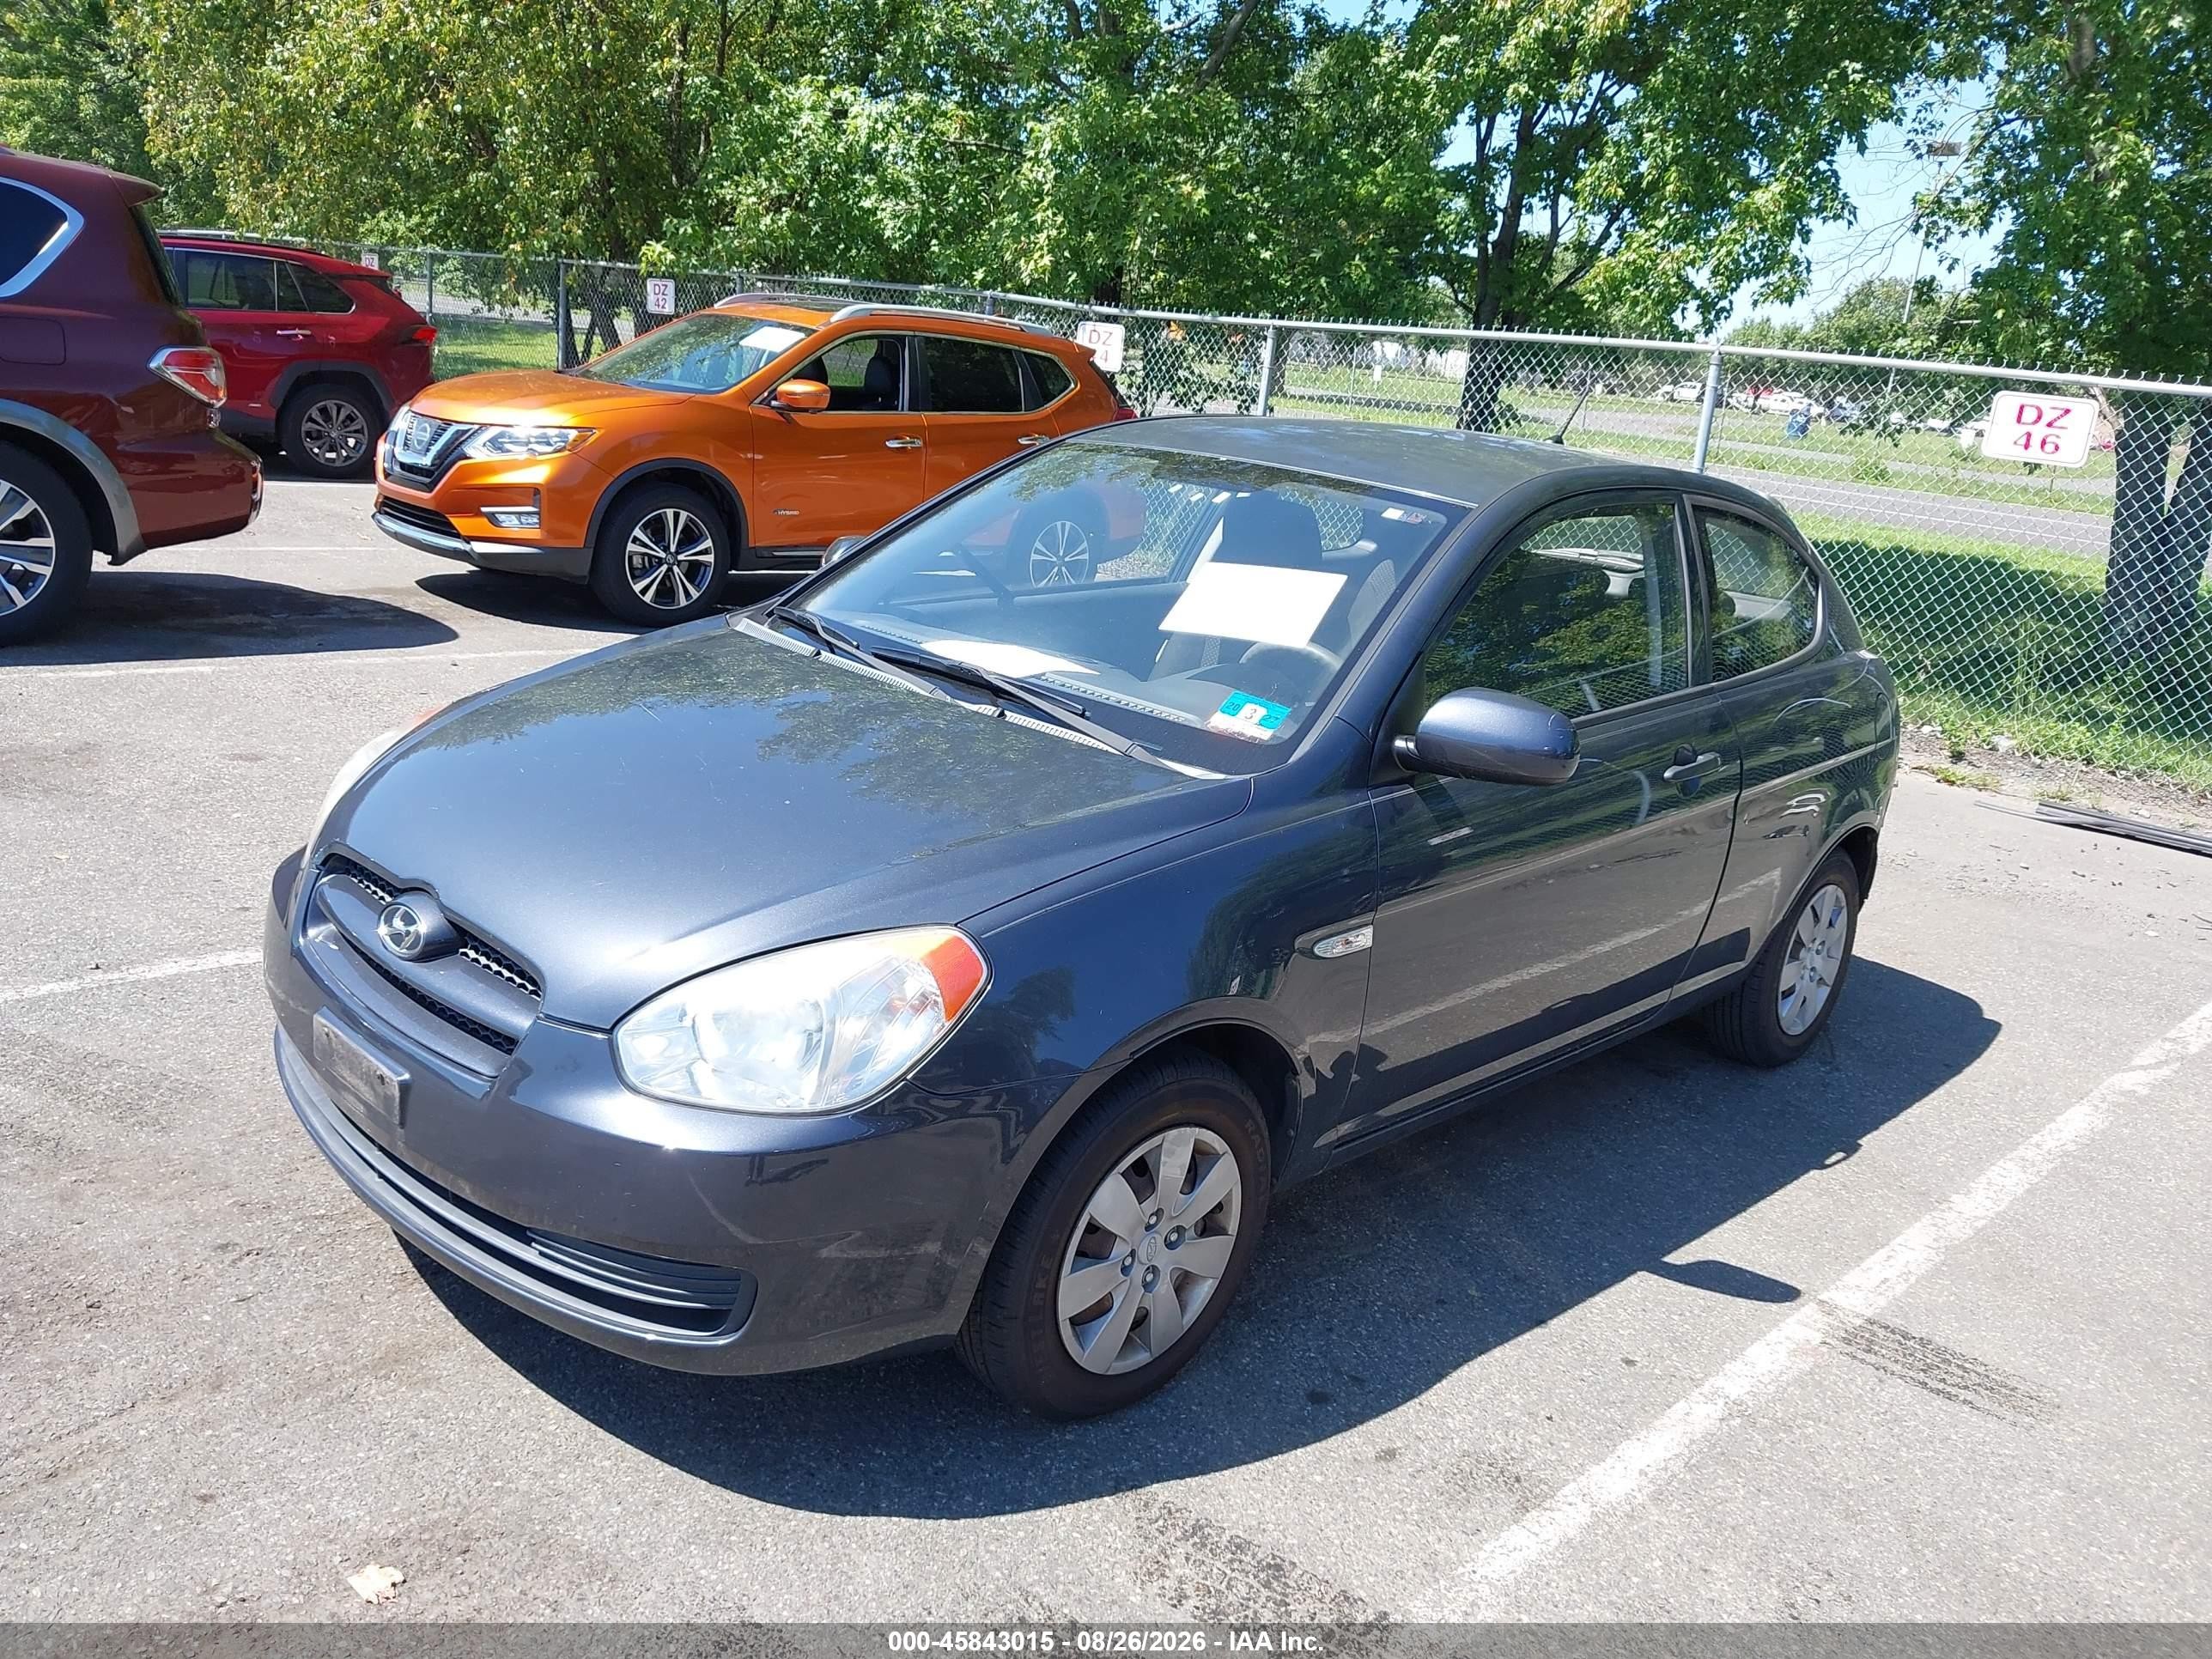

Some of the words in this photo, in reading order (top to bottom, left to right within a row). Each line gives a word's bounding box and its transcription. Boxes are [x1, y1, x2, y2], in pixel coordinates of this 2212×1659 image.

[653, 283, 668, 296] DZ
[654, 297, 667, 309] 42
[1089, 329, 1113, 346] DZ
[2015, 404, 2071, 429] DZ
[2013, 431, 2061, 454] 46
[1244, 708, 1257, 720] 3
